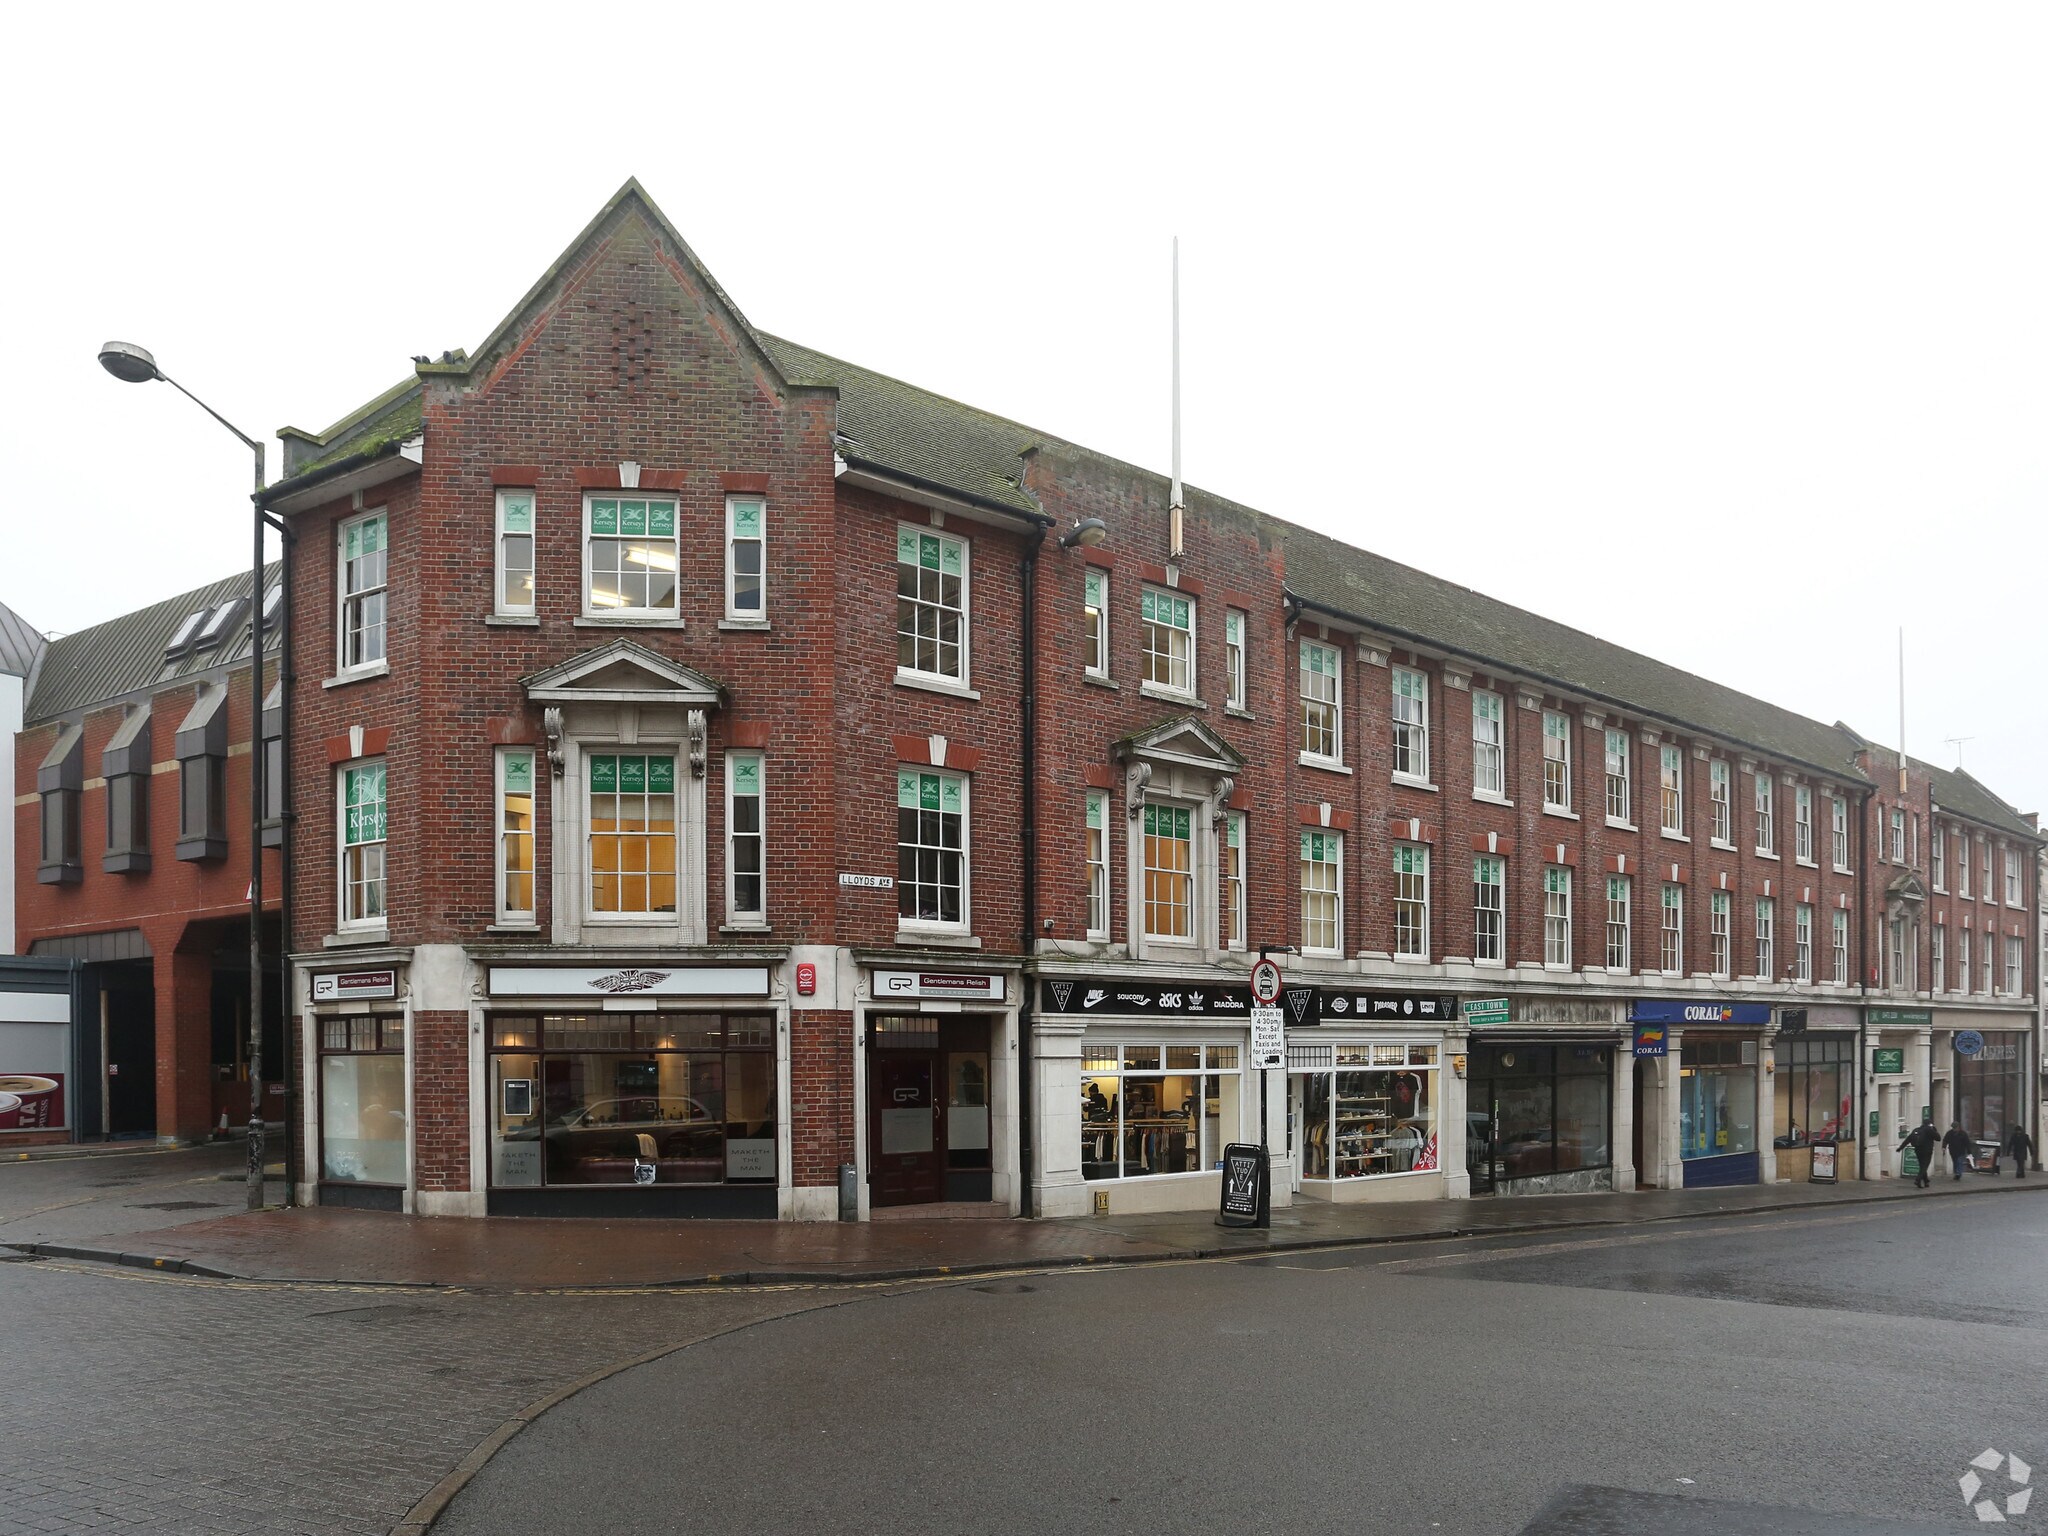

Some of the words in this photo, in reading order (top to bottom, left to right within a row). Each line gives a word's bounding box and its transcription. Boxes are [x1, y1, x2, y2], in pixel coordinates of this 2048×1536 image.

[650, 521, 673, 529] Kerseys
[842, 875, 875, 886] LLOYDS
[889, 978, 914, 992] GR
[923, 977, 965, 985] Gentlemans
[1087, 990, 1104, 1000] NIKE
[1117, 993, 1145, 1001] saucony
[1214, 1001, 1244, 1009] DIADORA
[1470, 1003, 1485, 1011] EAST
[1487, 1001, 1504, 1010] TOWN
[1684, 1006, 1719, 1020] CORAL
[1418, 1140, 1437, 1168] SALE
